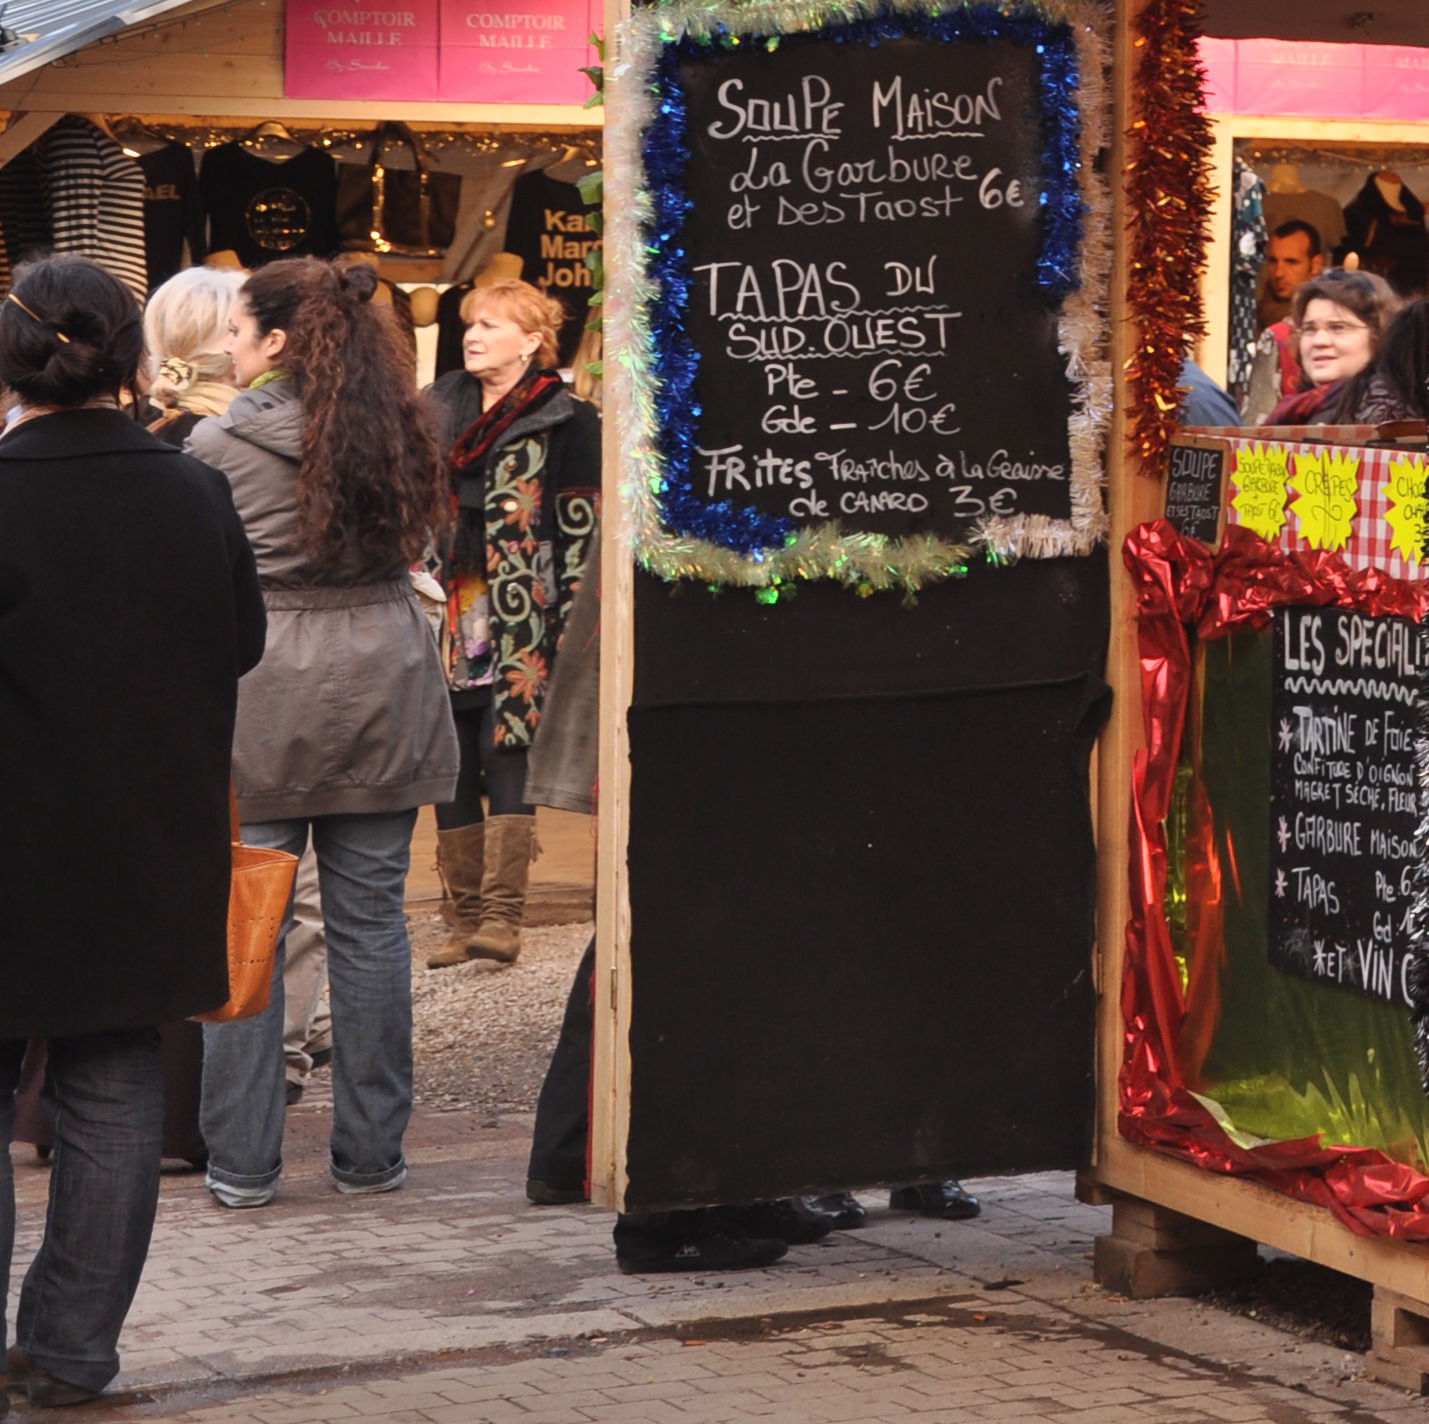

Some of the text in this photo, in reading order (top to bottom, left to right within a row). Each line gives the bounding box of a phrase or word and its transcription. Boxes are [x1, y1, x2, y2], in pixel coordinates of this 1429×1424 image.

[315, 10, 416, 27] COMPTOIR
[466, 13, 565, 30] COMPTOIR
[327, 32, 402, 46] MAILLE
[479, 34, 552, 49] MAILLE
[707, 76, 845, 139] SOUPE
[730, 147, 791, 192] La
[978, 168, 1025, 209] 6€
[727, 195, 761, 229] et
[839, 185, 964, 222] Taost
[692, 255, 938, 321] TAPAS DU
[765, 362, 819, 400] Pte
[761, 404, 818, 435] Gde
[935, 454, 959, 480] à
[1172, 448, 1218, 481] SOUPE
[788, 489, 830, 518] de
[839, 491, 928, 515] CANARD
[1284, 610, 1325, 676] LES
[1365, 718, 1379, 746] DE
[1295, 812, 1362, 856] GARBURE
[1292, 867, 1340, 916] TAPAS
